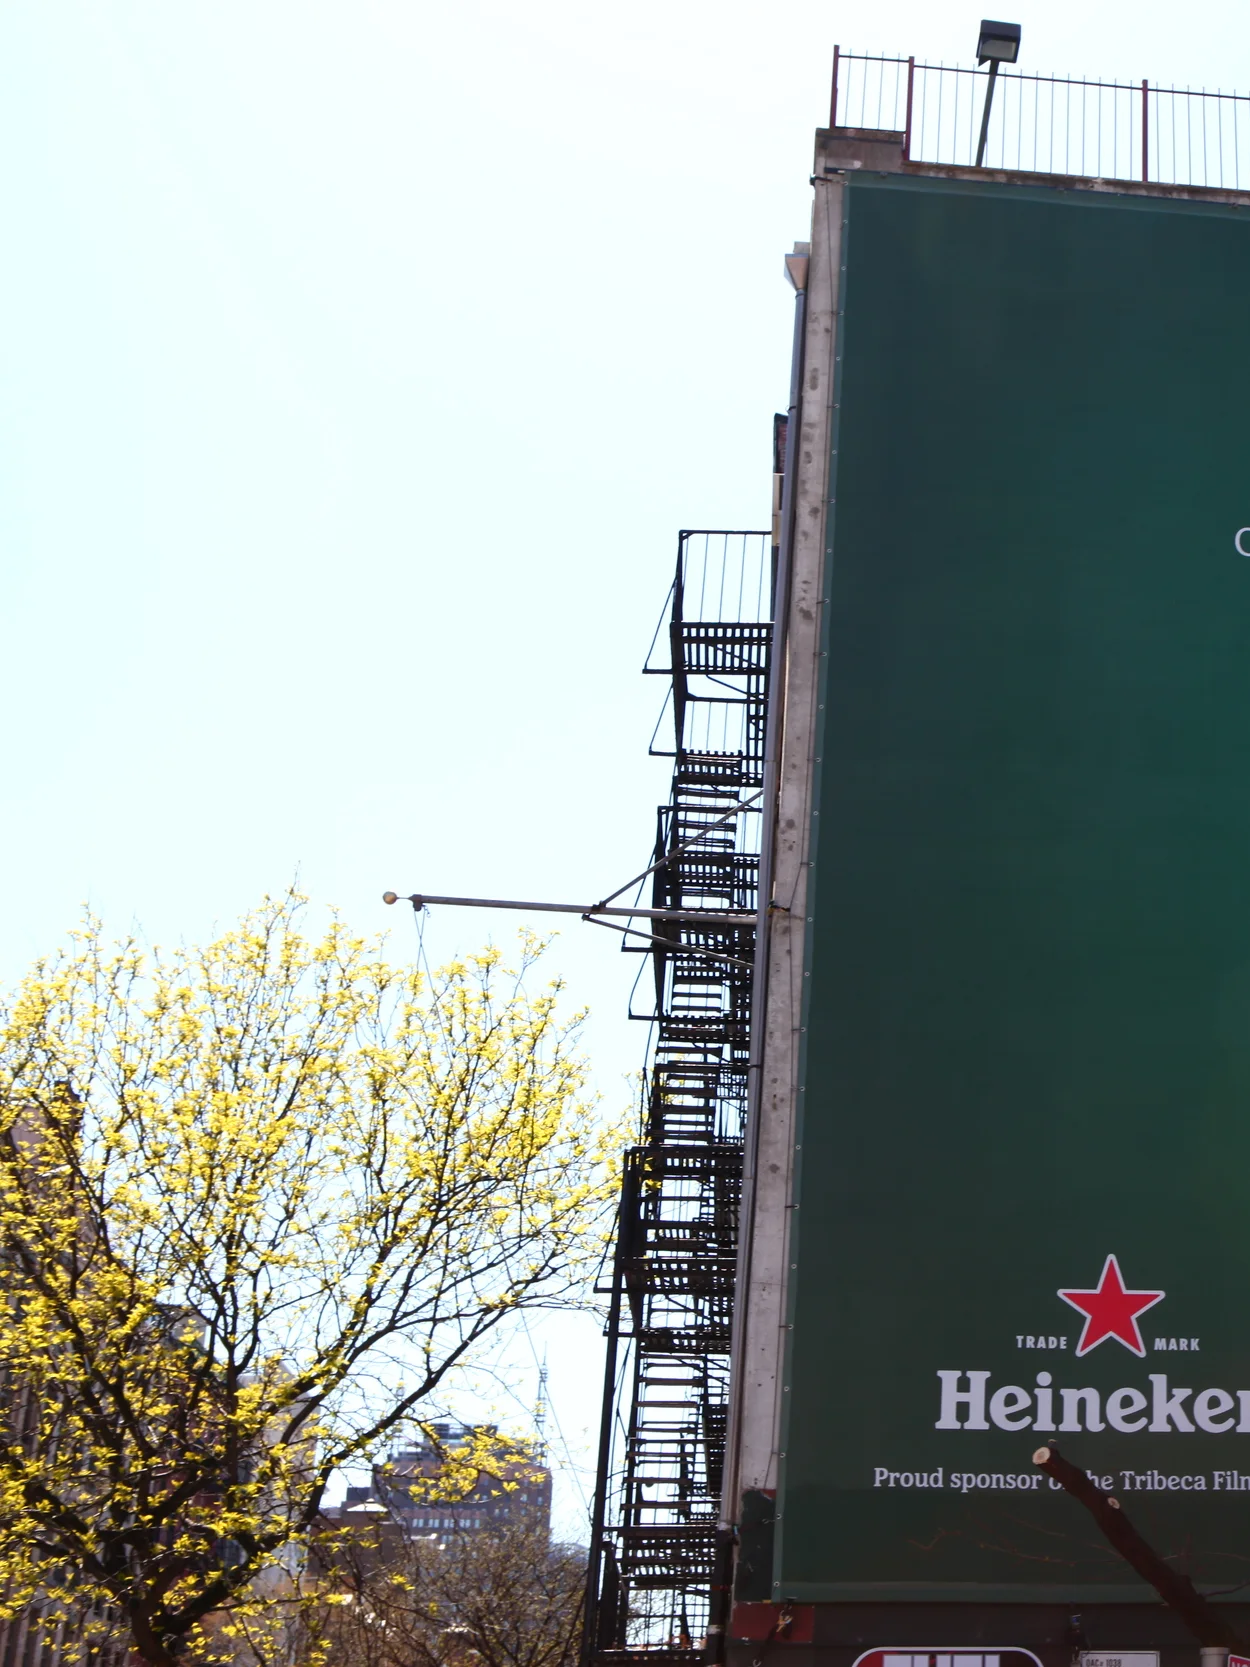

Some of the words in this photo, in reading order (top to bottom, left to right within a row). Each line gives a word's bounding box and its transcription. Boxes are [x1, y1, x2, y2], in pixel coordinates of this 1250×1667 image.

[1016, 1335, 1067, 1350] TRADE
[1153, 1337, 1200, 1351] MARK
[873, 1467, 944, 1488] Proud
[950, 1473, 1043, 1493] sponsor
[1085, 1469, 1114, 1491] he
[1119, 1469, 1207, 1491] Tribeca
